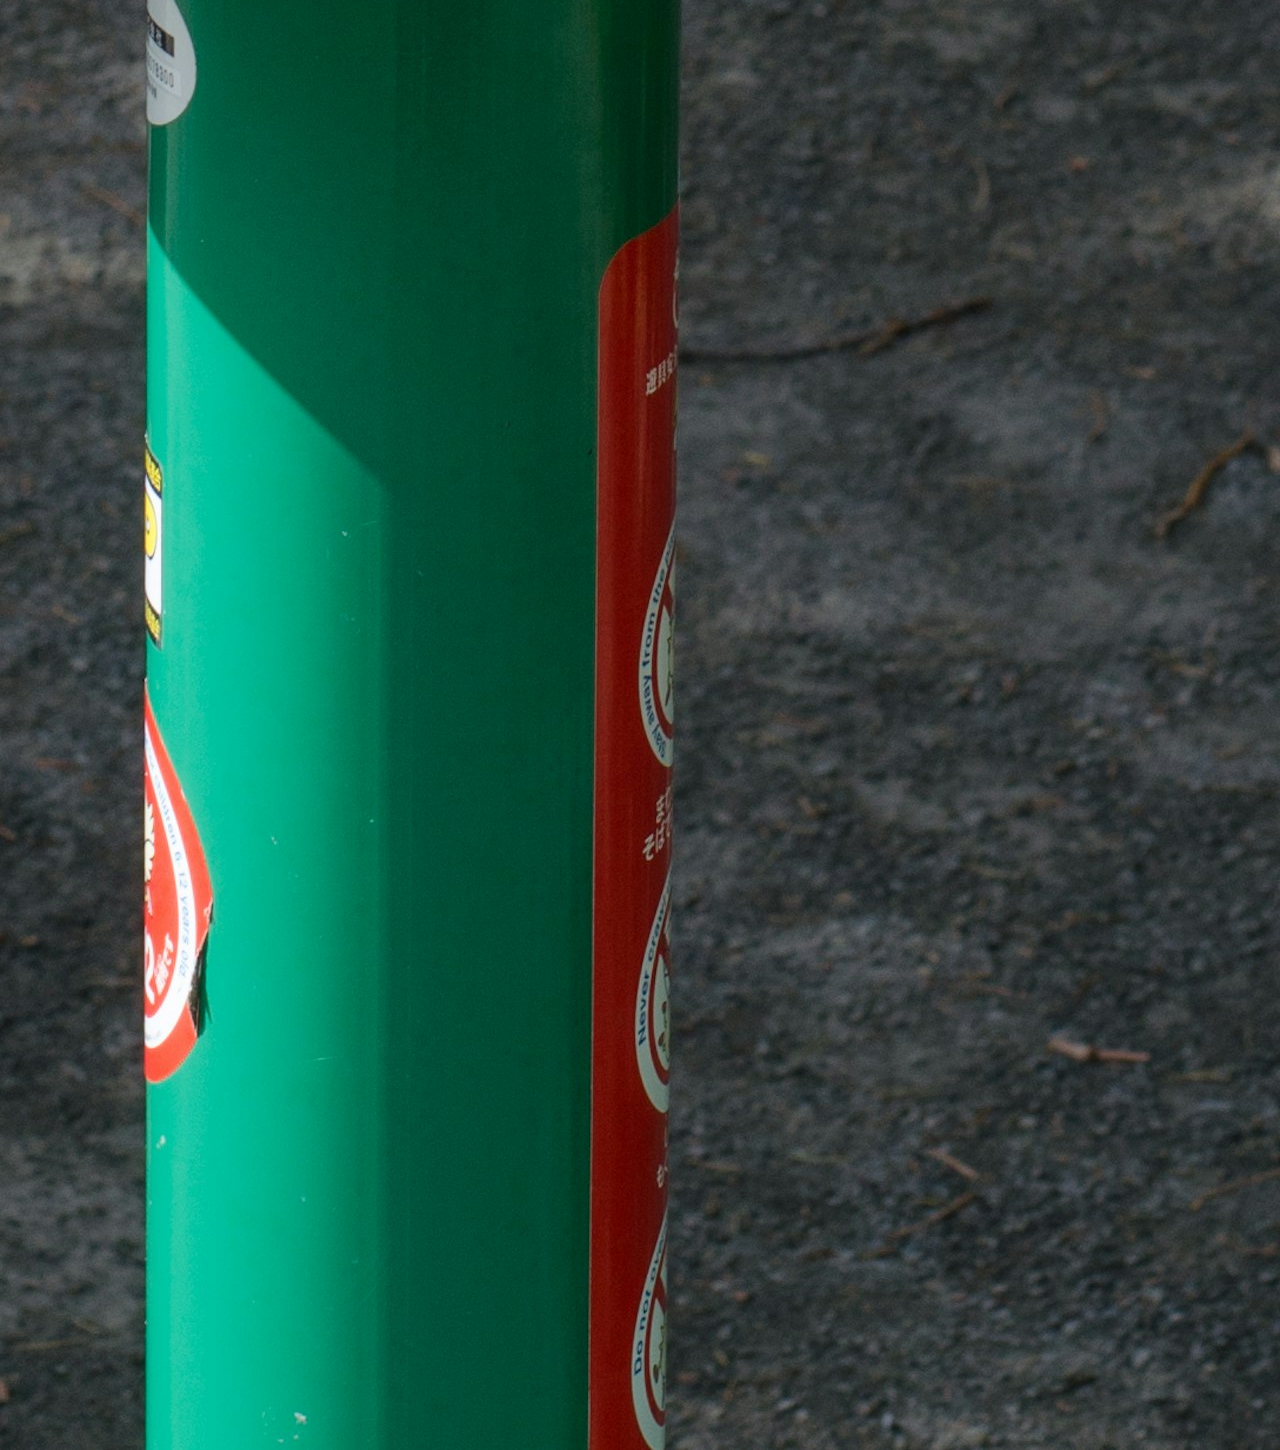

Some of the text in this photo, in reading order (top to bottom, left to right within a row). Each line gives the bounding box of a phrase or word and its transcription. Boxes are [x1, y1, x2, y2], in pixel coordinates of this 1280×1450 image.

[653, 567, 665, 605] the
[642, 610, 655, 667] from
[643, 674, 655, 726] away
[154, 773, 177, 847] children
[180, 894, 190, 946] years
[638, 972, 649, 1046] Never
[634, 1339, 643, 1375] Do
[640, 1290, 651, 1331] not
